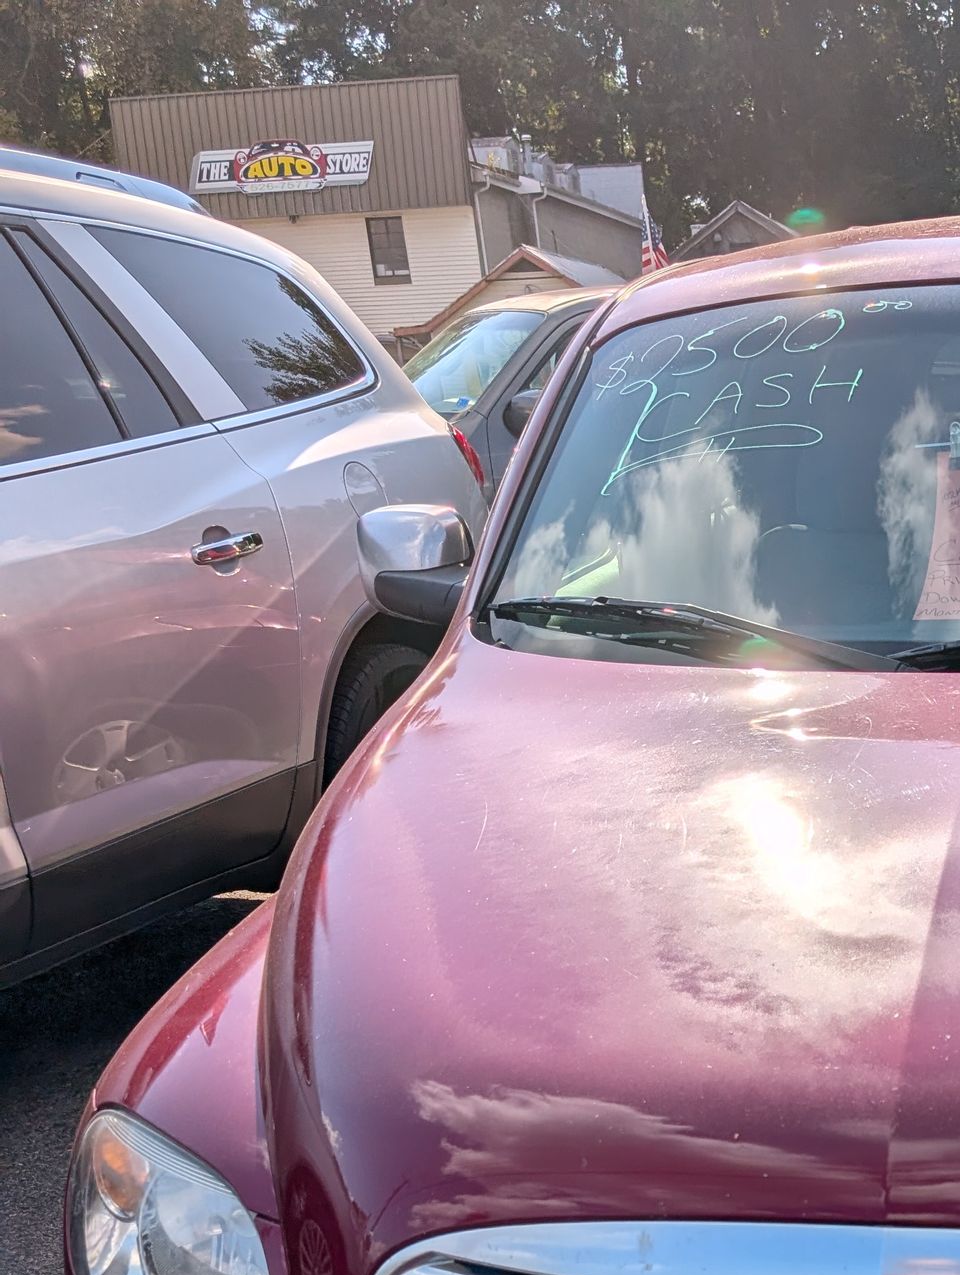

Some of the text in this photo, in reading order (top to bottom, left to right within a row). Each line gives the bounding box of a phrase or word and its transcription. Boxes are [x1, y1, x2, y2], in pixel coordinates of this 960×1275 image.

[200, 152, 369, 182] THE AUTO STORE
[636, 365, 864, 442] CASH
